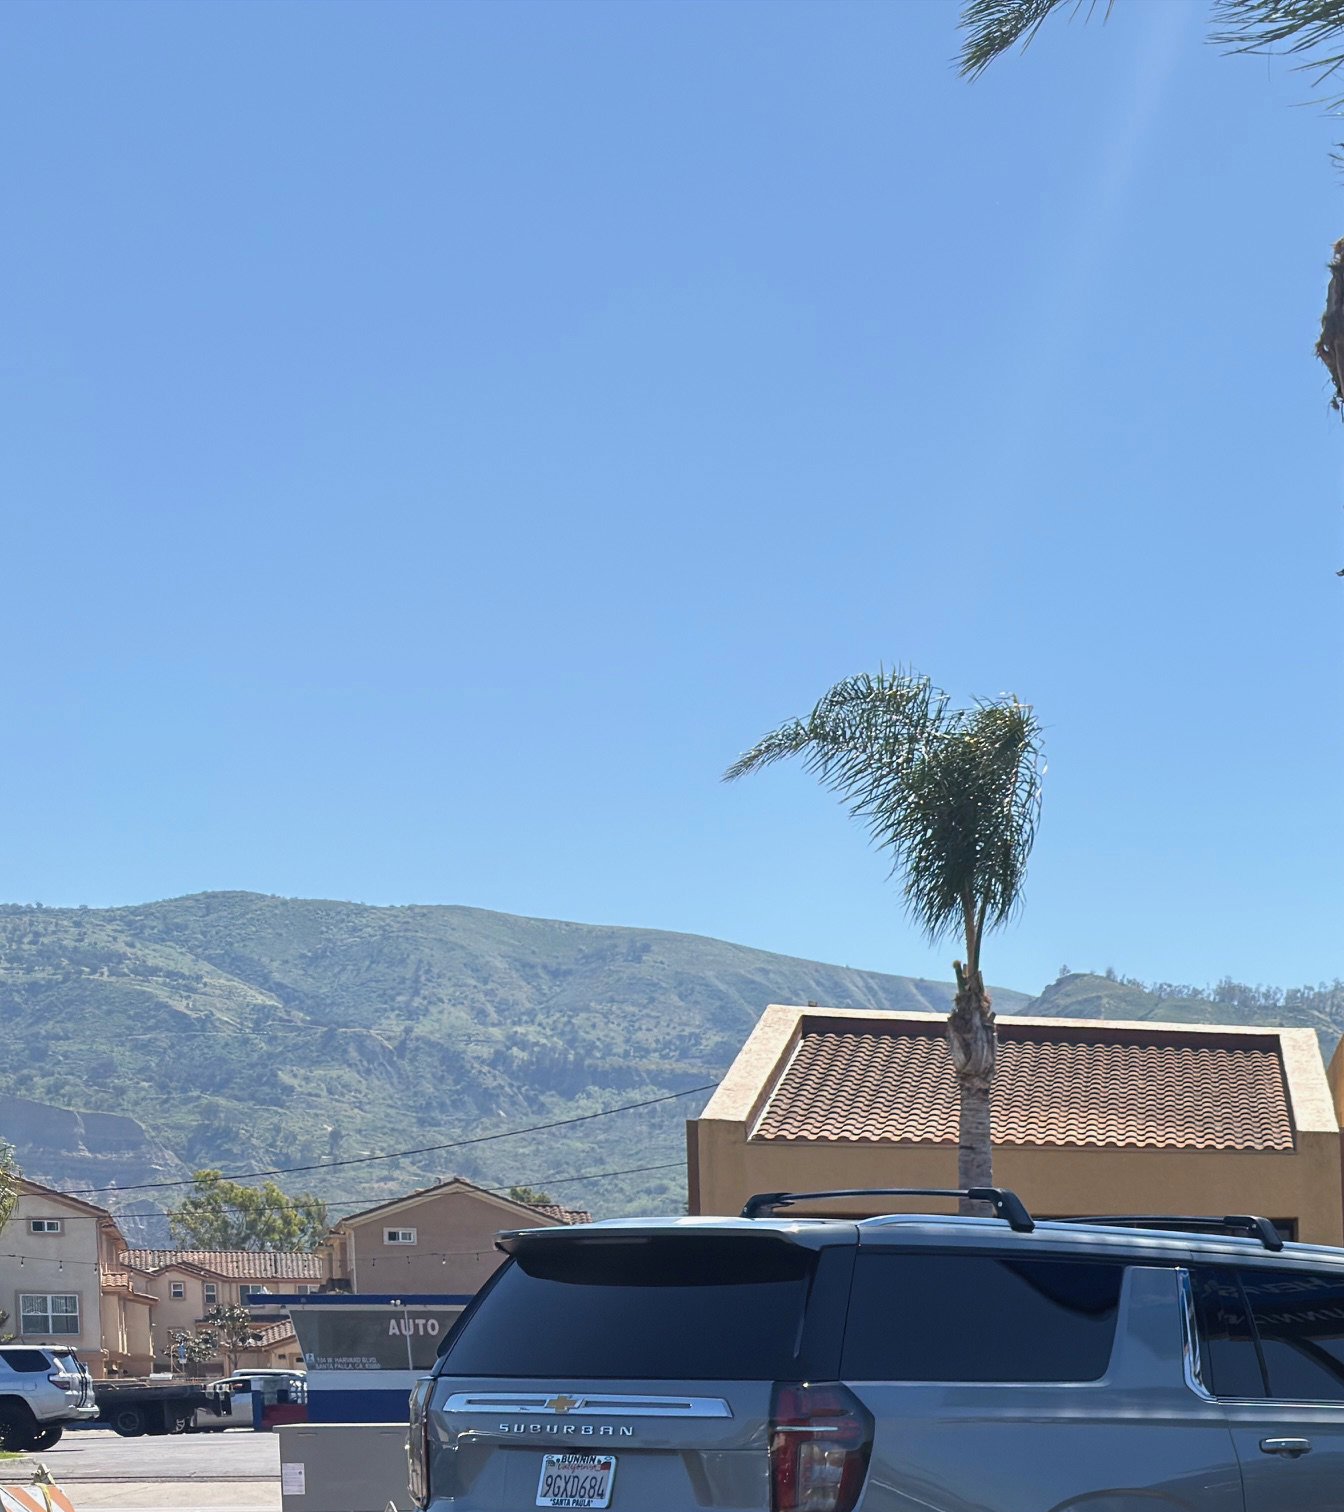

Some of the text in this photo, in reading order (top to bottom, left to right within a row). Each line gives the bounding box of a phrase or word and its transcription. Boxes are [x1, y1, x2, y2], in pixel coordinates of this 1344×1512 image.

[388, 1319, 440, 1336] AUTO
[499, 1423, 634, 1436] SUBURBAN
[542, 1474, 605, 1500] 9GXD684
